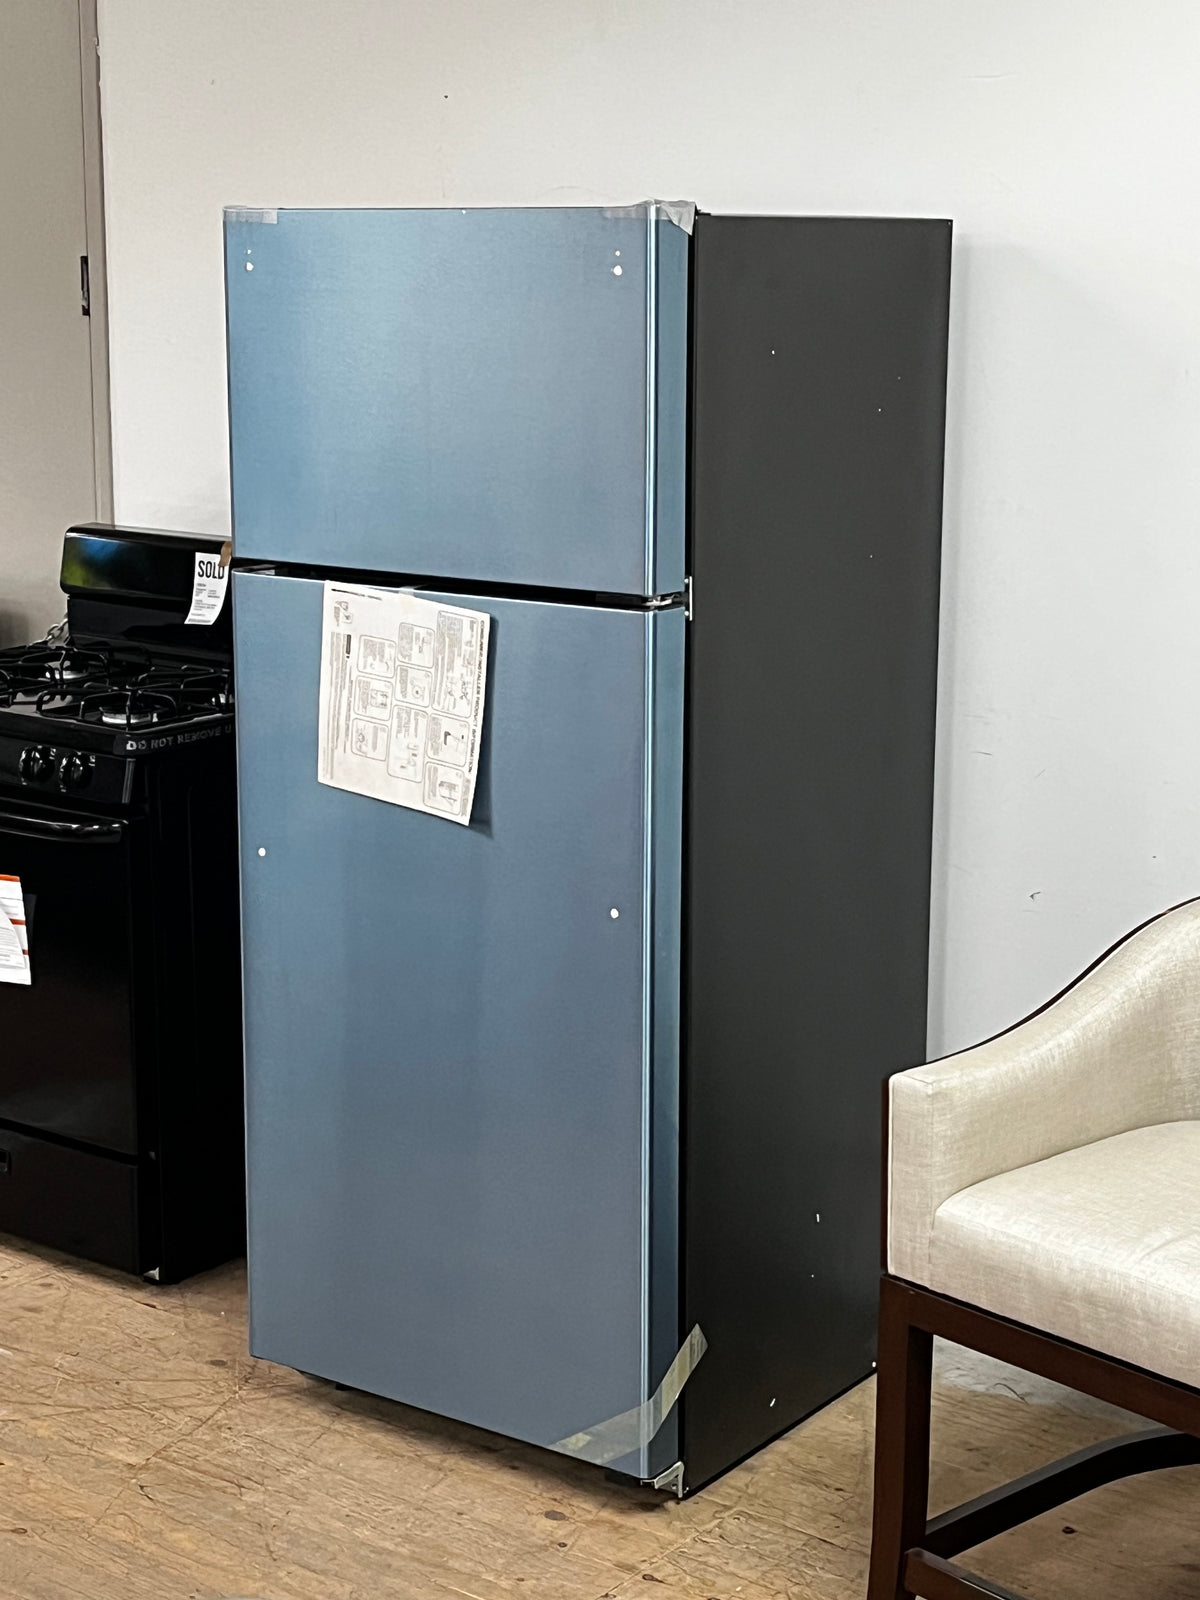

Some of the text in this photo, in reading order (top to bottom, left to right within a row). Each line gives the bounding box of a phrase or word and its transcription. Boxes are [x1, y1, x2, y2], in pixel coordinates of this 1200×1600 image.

[198, 560, 224, 580] SOLD
[126, 740, 147, 750] DO
[151, 737, 174, 749] NOT
[177, 726, 222, 744] REMOVE
